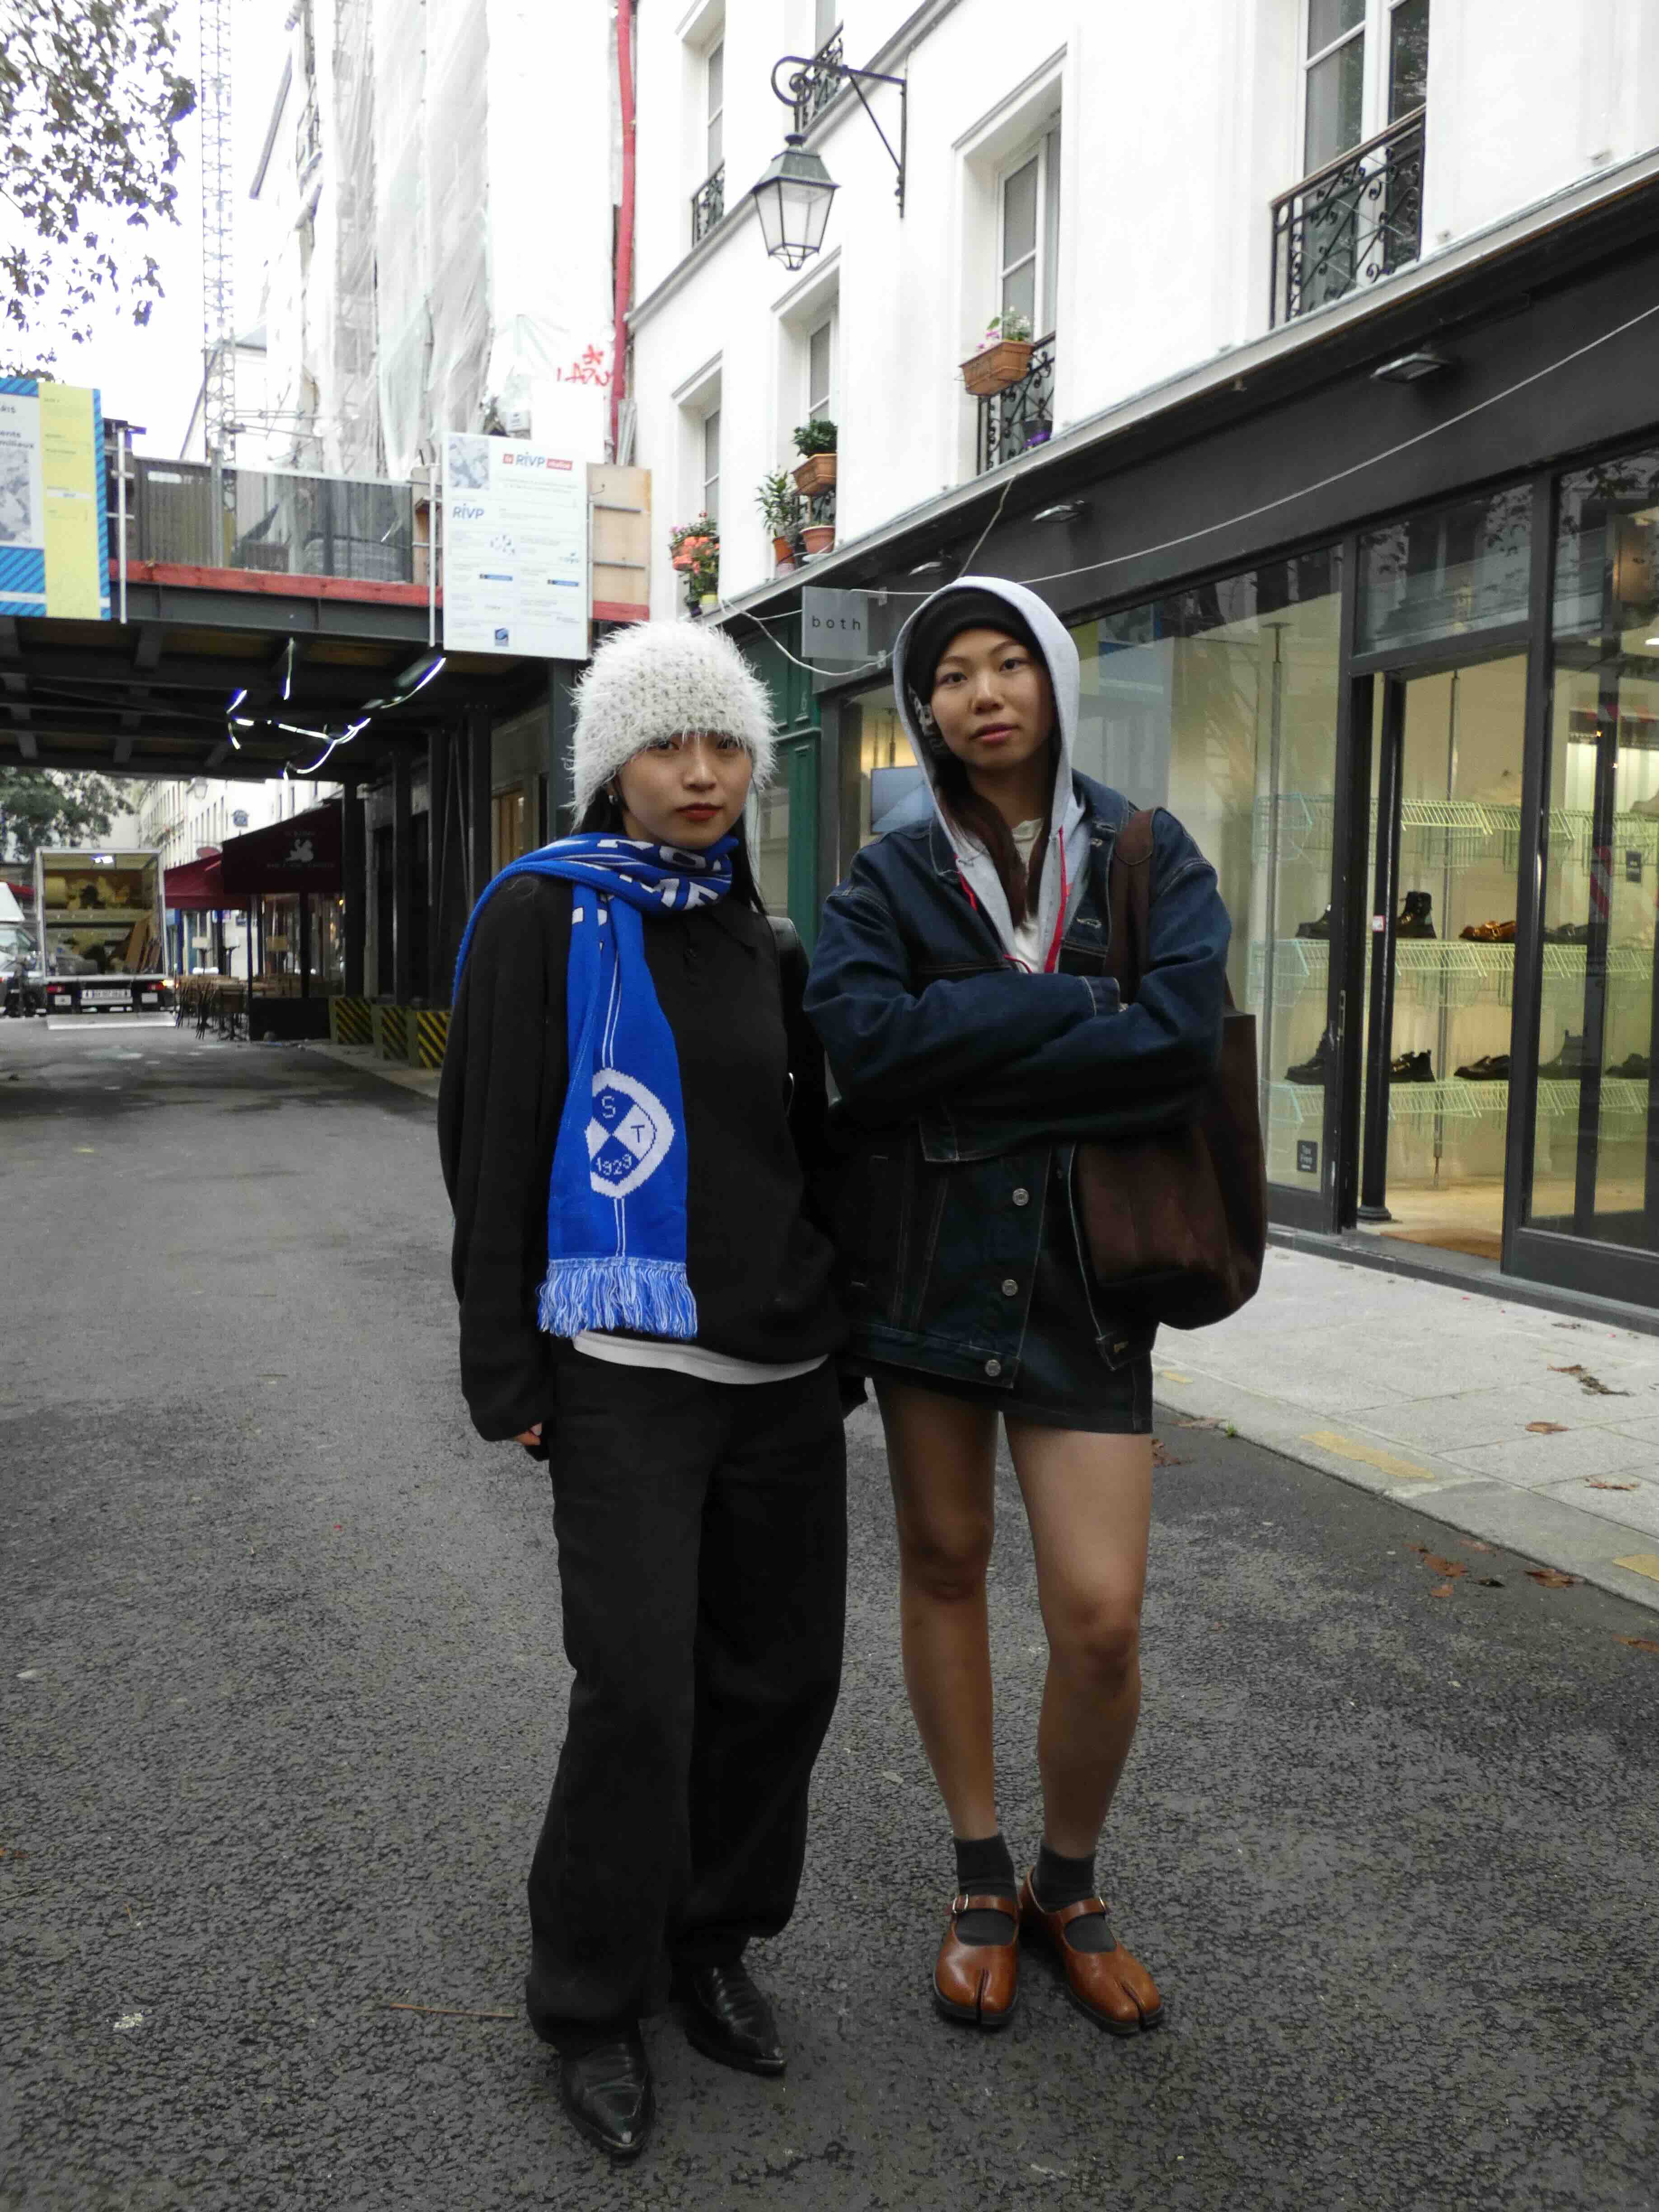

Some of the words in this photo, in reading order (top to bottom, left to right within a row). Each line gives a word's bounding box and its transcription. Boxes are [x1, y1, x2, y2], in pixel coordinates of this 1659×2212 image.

[812, 615, 861, 631] both
[601, 1095, 616, 1119] S
[630, 1124, 645, 1143] T
